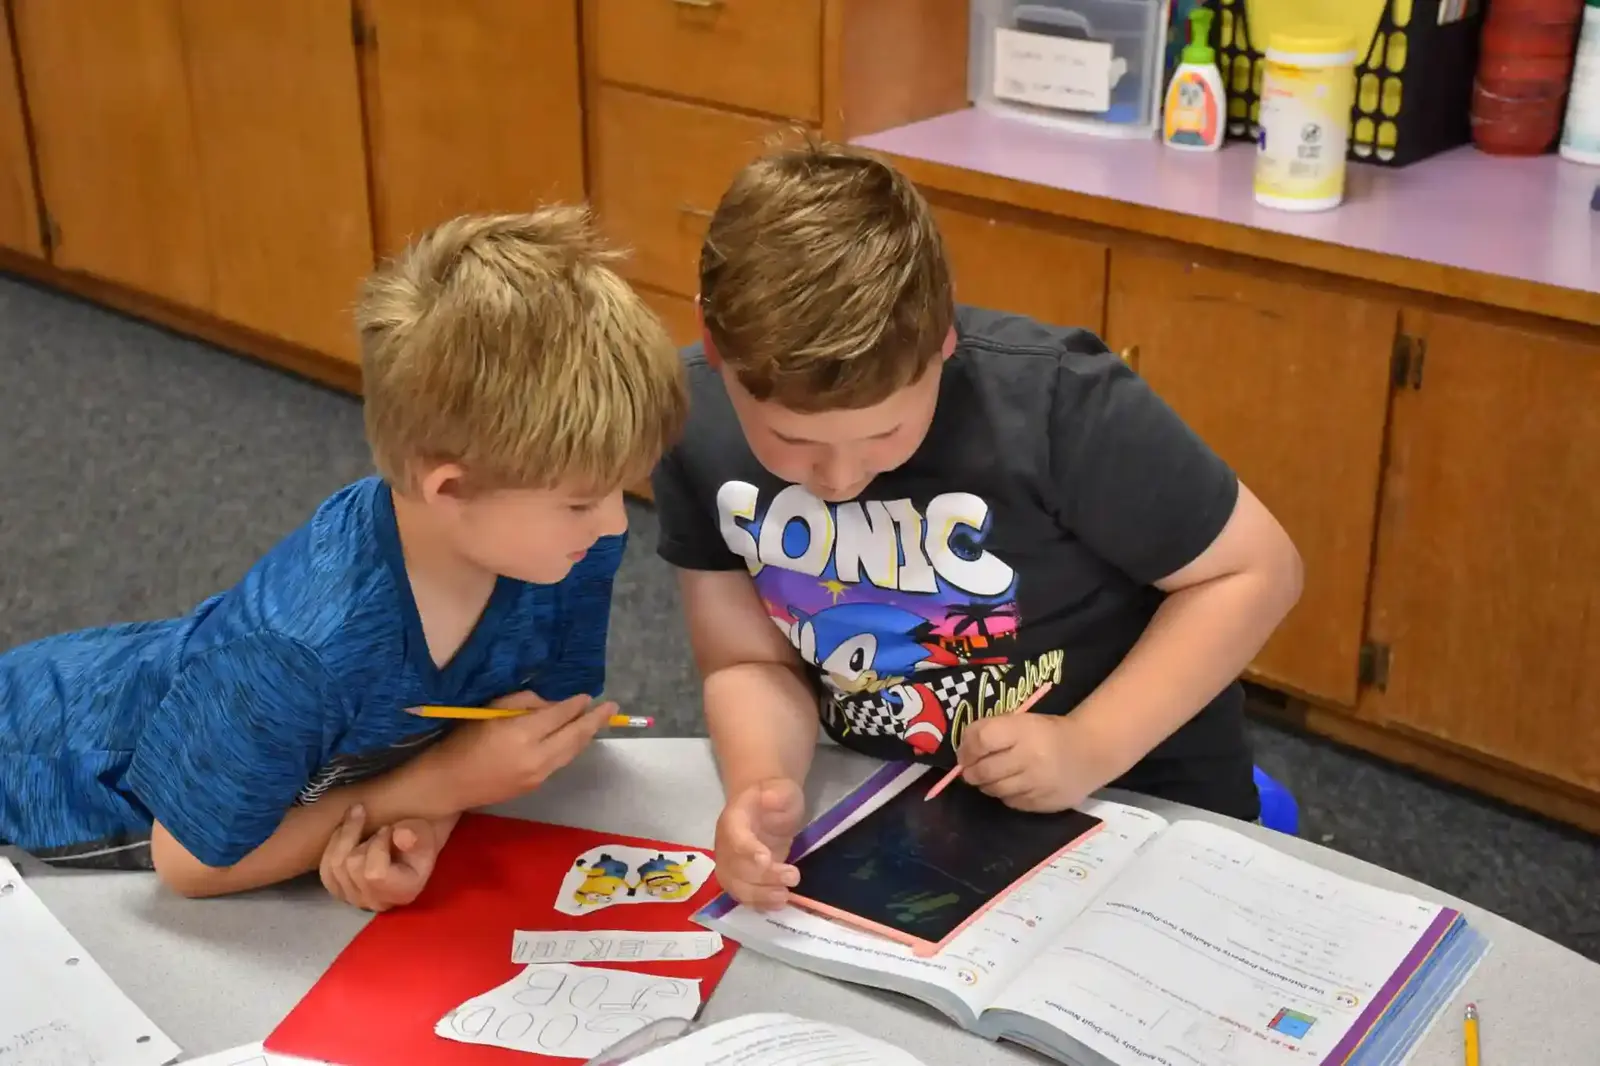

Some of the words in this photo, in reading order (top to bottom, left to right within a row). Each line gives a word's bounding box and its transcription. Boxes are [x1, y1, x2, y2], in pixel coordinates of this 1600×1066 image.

[716, 480, 1015, 596] SONIC
[1105, 896, 1140, 917] Numbers
[1138, 907, 1179, 931] Two-Digit
[1177, 926, 1214, 948] Multiply
[1220, 948, 1259, 969] Property
[1257, 964, 1308, 990] Distributive
[512, 966, 688, 1020] JOB
[1308, 984, 1325, 995] Use
[1042, 998, 1082, 1021] Numbers
[1078, 1016, 1122, 1043] Two-Digit
[1119, 1039, 1157, 1062] Multiply
[1156, 1056, 1167, 1065] to
